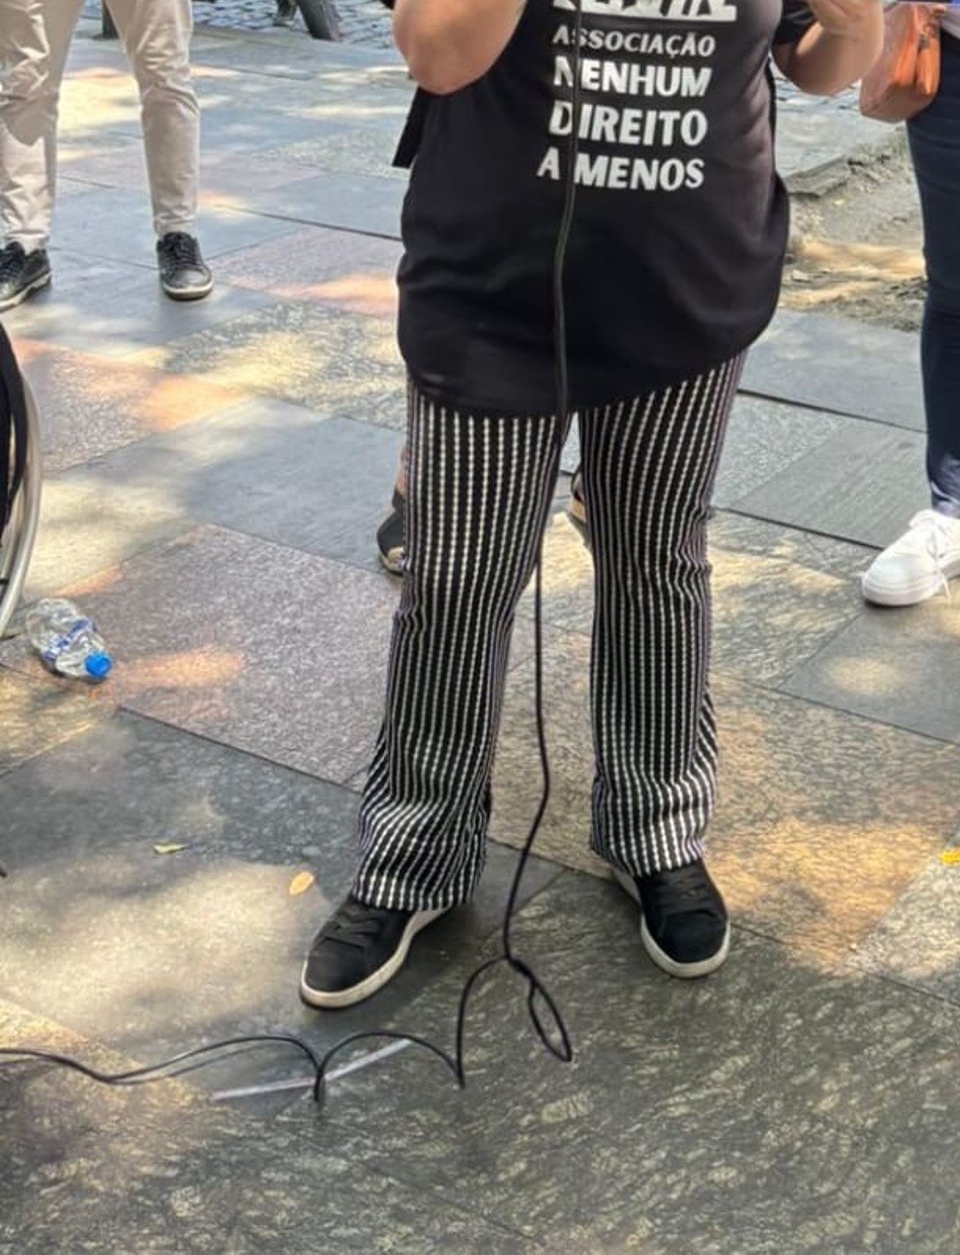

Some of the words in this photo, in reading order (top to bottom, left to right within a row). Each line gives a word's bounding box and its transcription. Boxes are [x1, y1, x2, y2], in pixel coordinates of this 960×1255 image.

[552, 24, 716, 59] ASSOCIAÇÃO
[553, 55, 713, 97] NENHUM
[549, 100, 708, 146] DIREITO
[536, 146, 561, 181] A
[573, 152, 705, 191] MENOS
